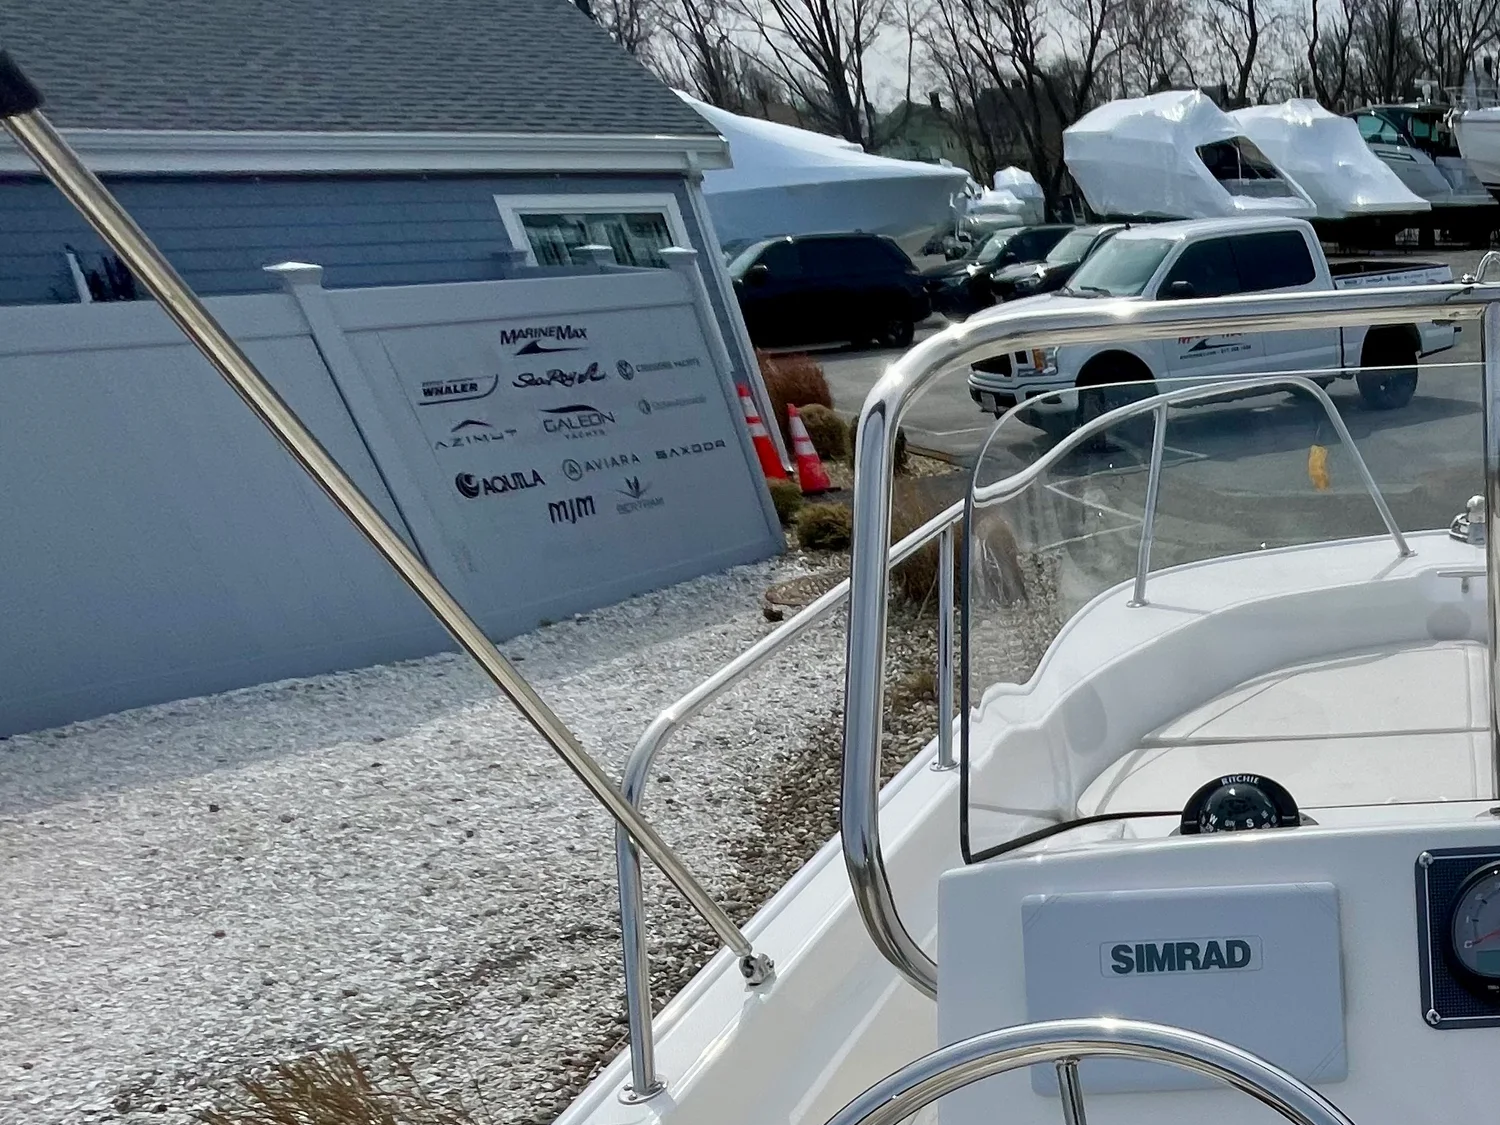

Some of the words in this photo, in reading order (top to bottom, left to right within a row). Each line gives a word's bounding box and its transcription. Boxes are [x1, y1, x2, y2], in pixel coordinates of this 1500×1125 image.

[422, 383, 478, 397] WHALER
[543, 411, 615, 433] GALEON
[584, 453, 641, 472] AVIARA
[482, 469, 546, 495] AQUILA
[1221, 775, 1260, 786] RITCHIE
[1246, 818, 1254, 828] S
[1110, 939, 1251, 975] SIMRAD
